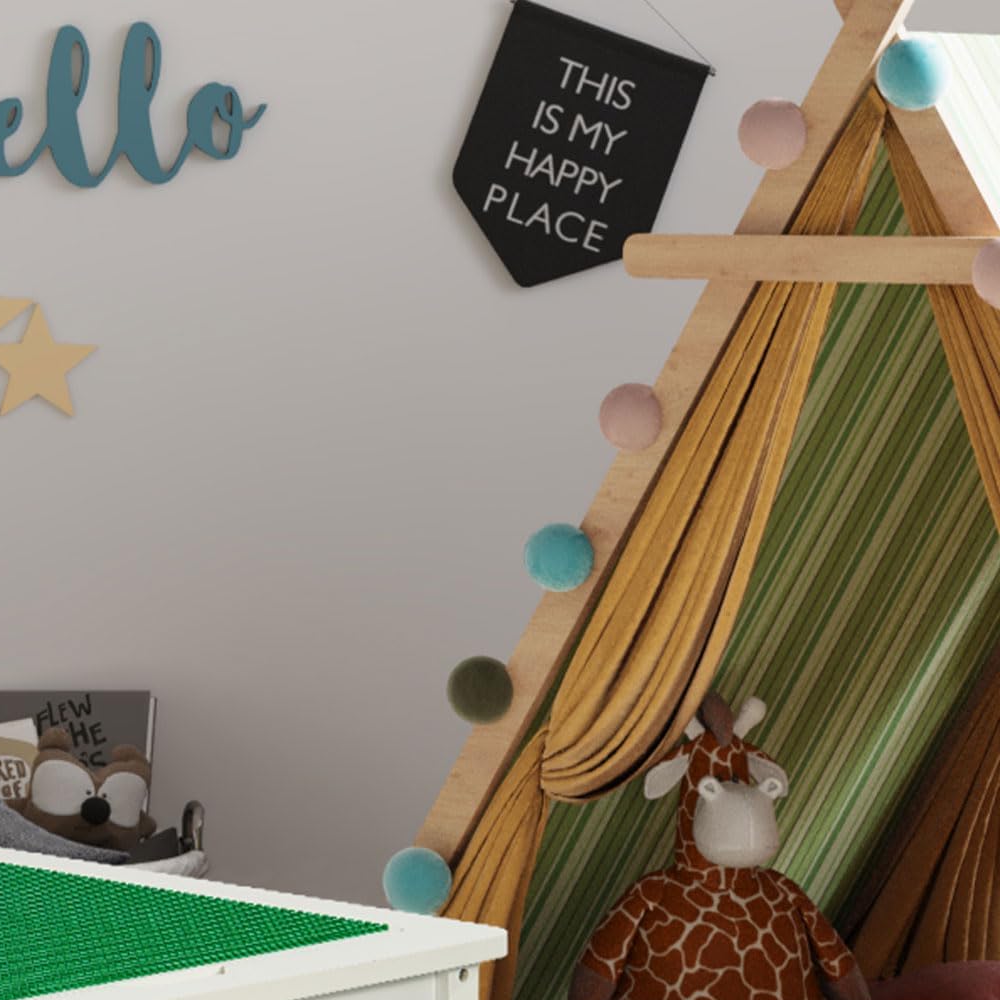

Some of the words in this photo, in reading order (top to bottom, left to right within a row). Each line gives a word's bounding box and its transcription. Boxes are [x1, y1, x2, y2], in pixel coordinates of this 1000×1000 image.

[560, 56, 636, 110] THIS
[532, 100, 564, 135] IS
[568, 113, 628, 156] MY
[504, 140, 623, 204] HAPPY
[482, 183, 608, 253] PLACE
[36, 693, 92, 738] FLEW
[66, 721, 107, 748] HE
